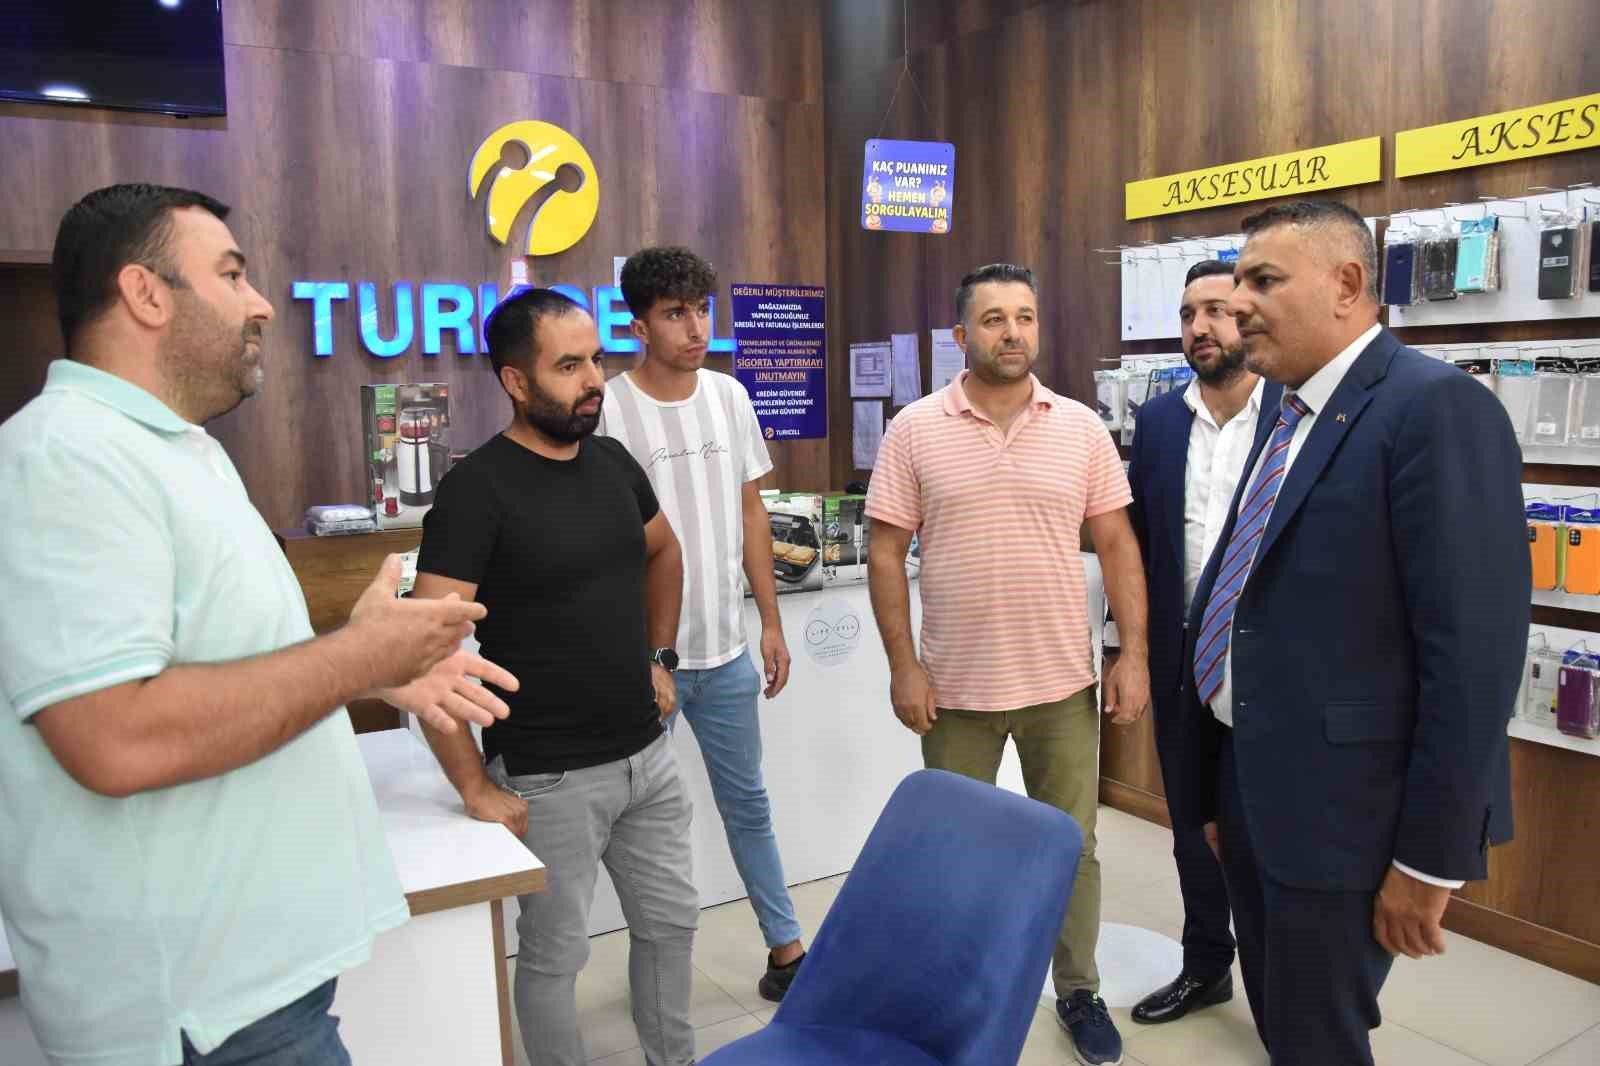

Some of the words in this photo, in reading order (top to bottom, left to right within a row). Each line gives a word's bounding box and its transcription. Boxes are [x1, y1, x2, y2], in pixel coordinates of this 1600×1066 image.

[1452, 104, 1599, 160] AKSES
[872, 160, 894, 175] KAÇ
[896, 162, 948, 176] PUANINIZ
[894, 176, 922, 188] VAR?
[1162, 154, 1330, 207] AKSESUAR
[888, 191, 926, 203] HEMEN
[865, 203, 947, 219] SORGULAYALIM
[733, 286, 764, 297] DEĞERLİ
[765, 287, 825, 299] MÜŞTERİLERİMİZ
[758, 302, 802, 311] MAĞAZAMIZDA
[292, 281, 737, 357] TUREL
[751, 312, 773, 321] YAPMIŞ
[773, 311, 810, 320] OLDUĞUNUZ
[734, 320, 756, 329] KREDİLİ
[757, 321, 765, 329] VE
[765, 321, 791, 329] FATURALI
[792, 321, 825, 330] İŞLEMLERDE
[736, 357, 773, 368] SİGORTA
[774, 358, 823, 368] YAPTIRMAYI
[755, 372, 806, 381] UNUTMAYIN
[756, 389, 779, 397] KREDİM
[779, 389, 806, 398] GÜVENDE
[786, 398, 814, 406] GÜVENDE
[779, 407, 806, 416] GÜVENDE
